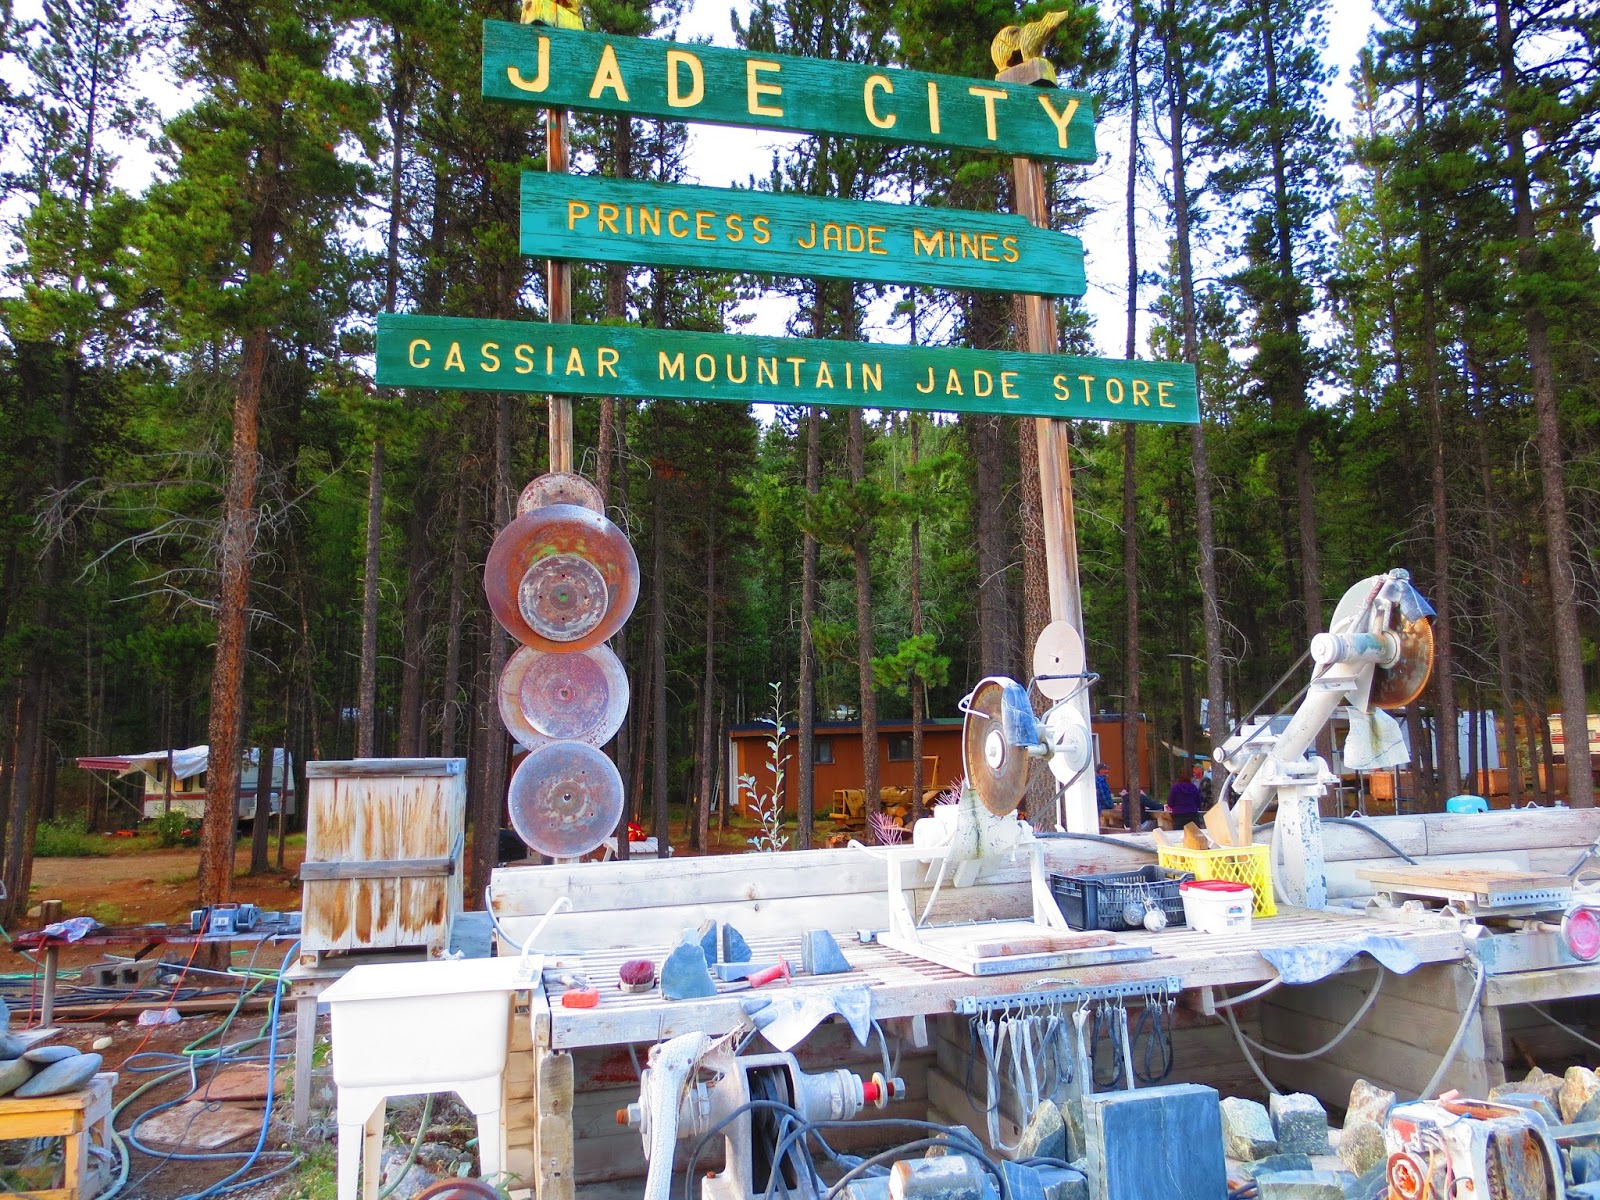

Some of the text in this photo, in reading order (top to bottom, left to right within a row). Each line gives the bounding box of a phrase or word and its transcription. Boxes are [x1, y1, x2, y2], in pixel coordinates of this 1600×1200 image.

[506, 35, 1080, 149] JADE CITY
[567, 200, 1020, 264] PRINCESS JADE MINES
[408, 338, 1176, 409] CASSIAR MOUNTAIN JADE STORE
